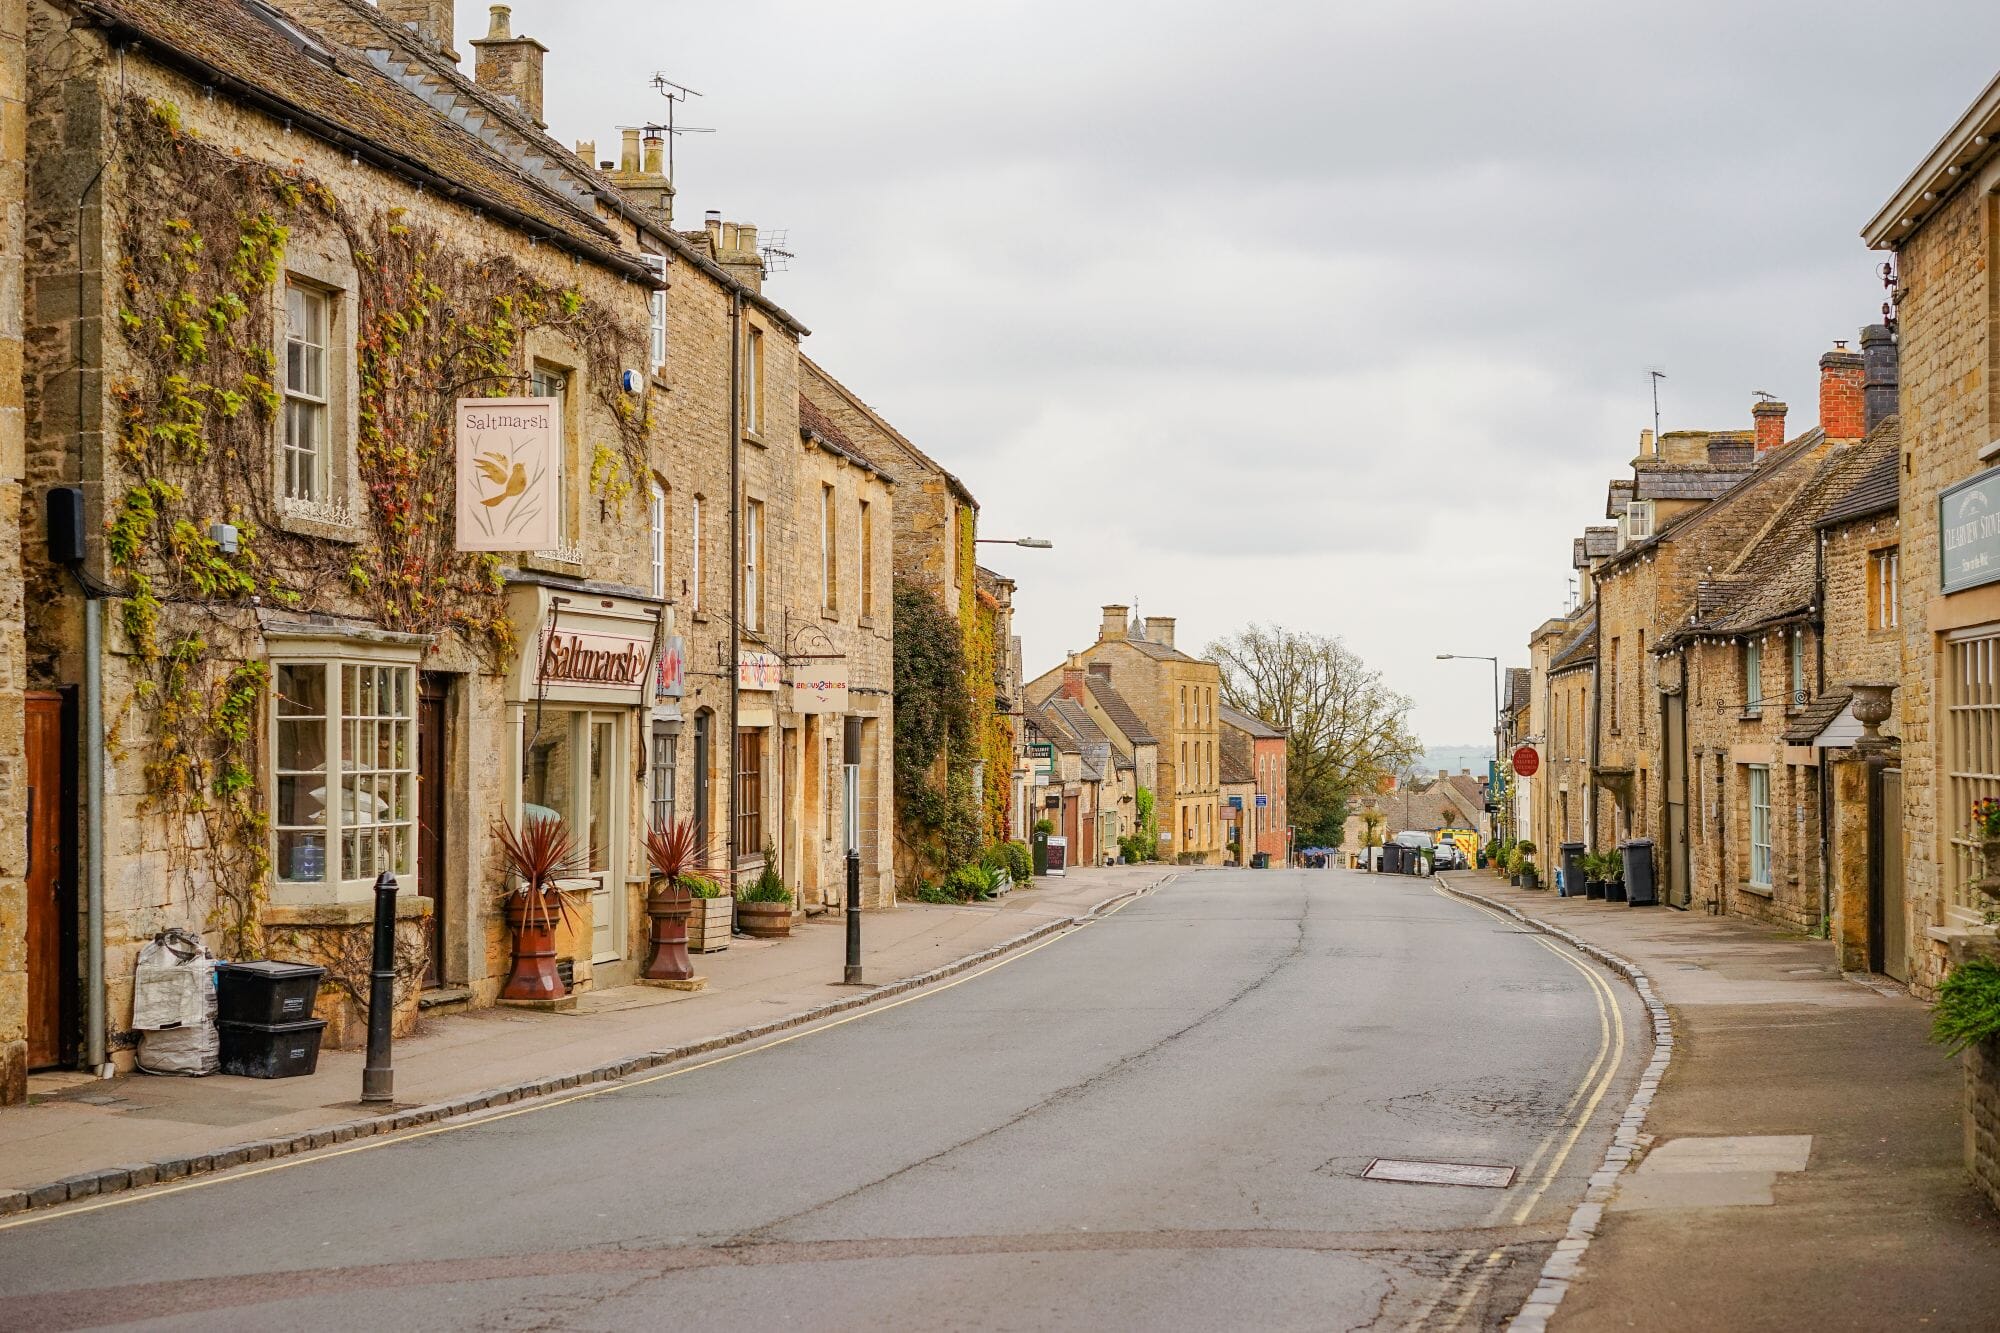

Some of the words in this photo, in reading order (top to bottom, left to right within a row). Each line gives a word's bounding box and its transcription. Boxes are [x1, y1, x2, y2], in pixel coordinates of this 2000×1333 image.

[466, 413, 549, 430] Saltmarsh
[1944, 520, 1978, 551] CLEARVIEW
[543, 635, 638, 683] Saltmarsh
[795, 680, 846, 691] groovy2shoes
